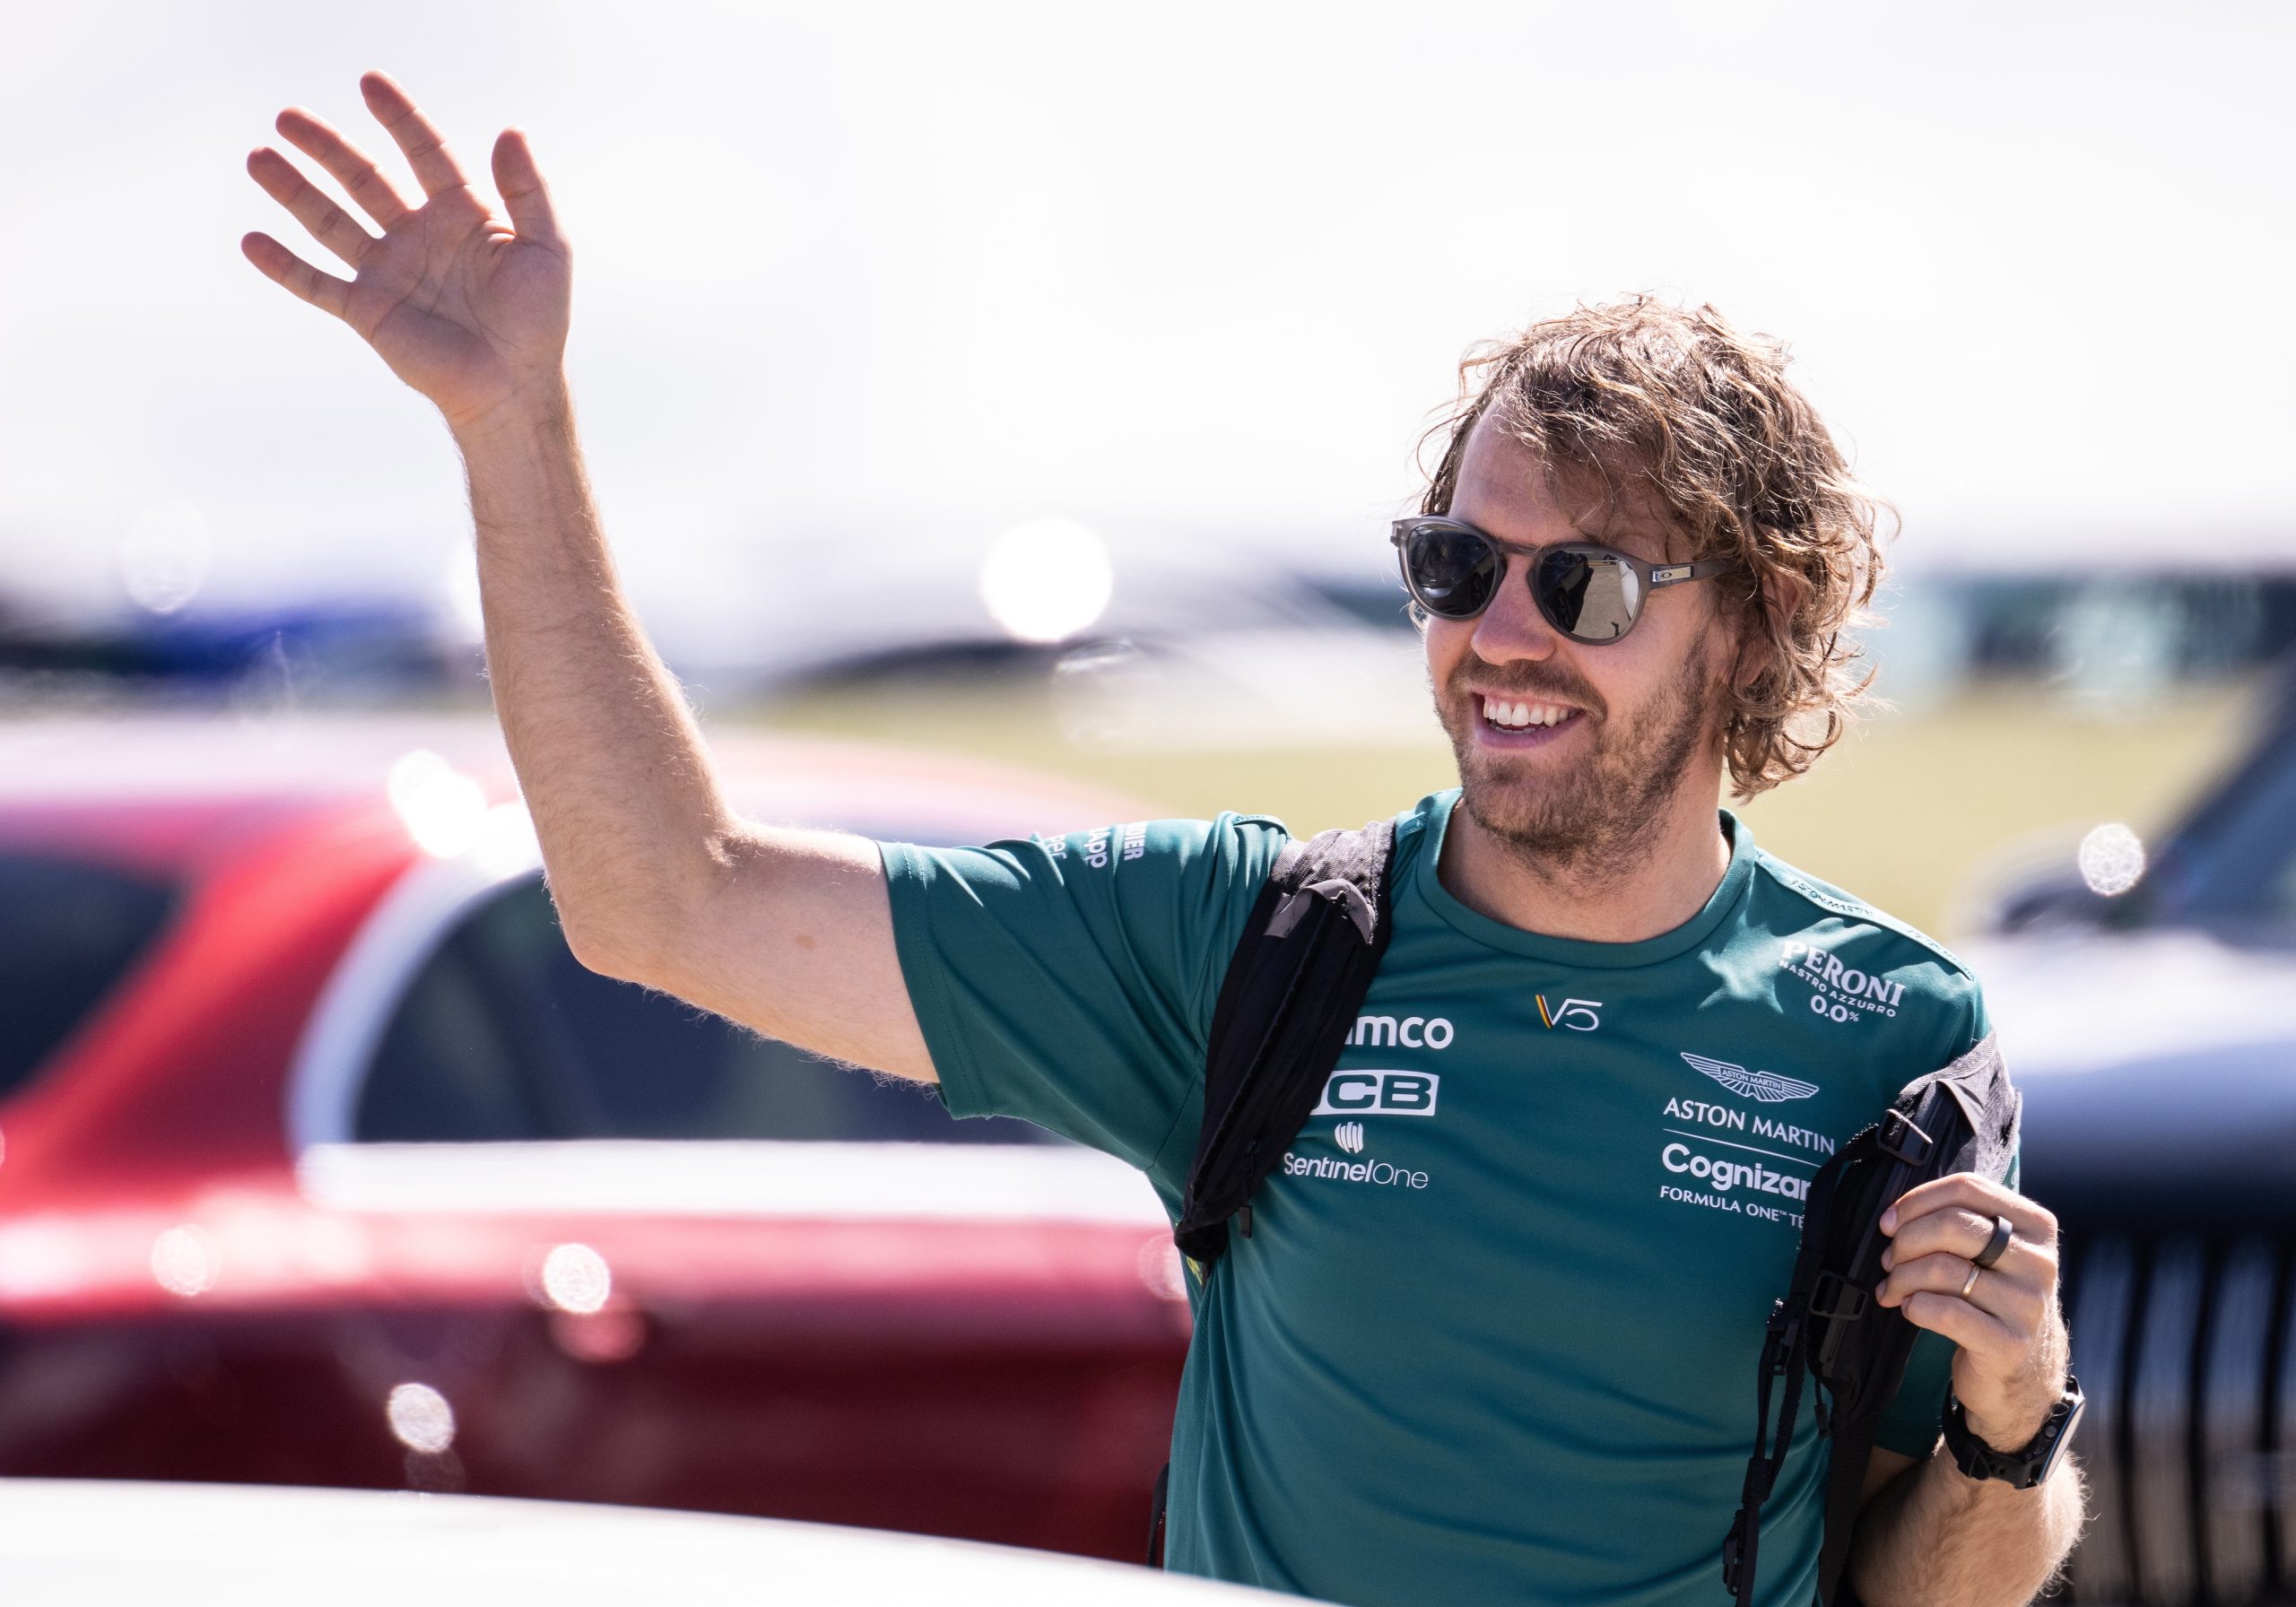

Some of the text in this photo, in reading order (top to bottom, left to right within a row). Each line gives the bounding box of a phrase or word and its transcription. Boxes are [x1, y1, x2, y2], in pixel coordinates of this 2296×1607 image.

[1779, 960, 1897, 1018] NASTRO AZZURRO
[1780, 941, 1906, 1007] PERONI
[1810, 995, 1859, 1023] 0.0%
[1310, 1074, 1432, 1110] CB
[1720, 1069, 1782, 1090] ASTON MARTIN
[1663, 1097, 1835, 1156] ASTON MARTIN
[1283, 1151, 1429, 1190] SentinelOne
[1660, 1186, 1741, 1213] FORMULA
